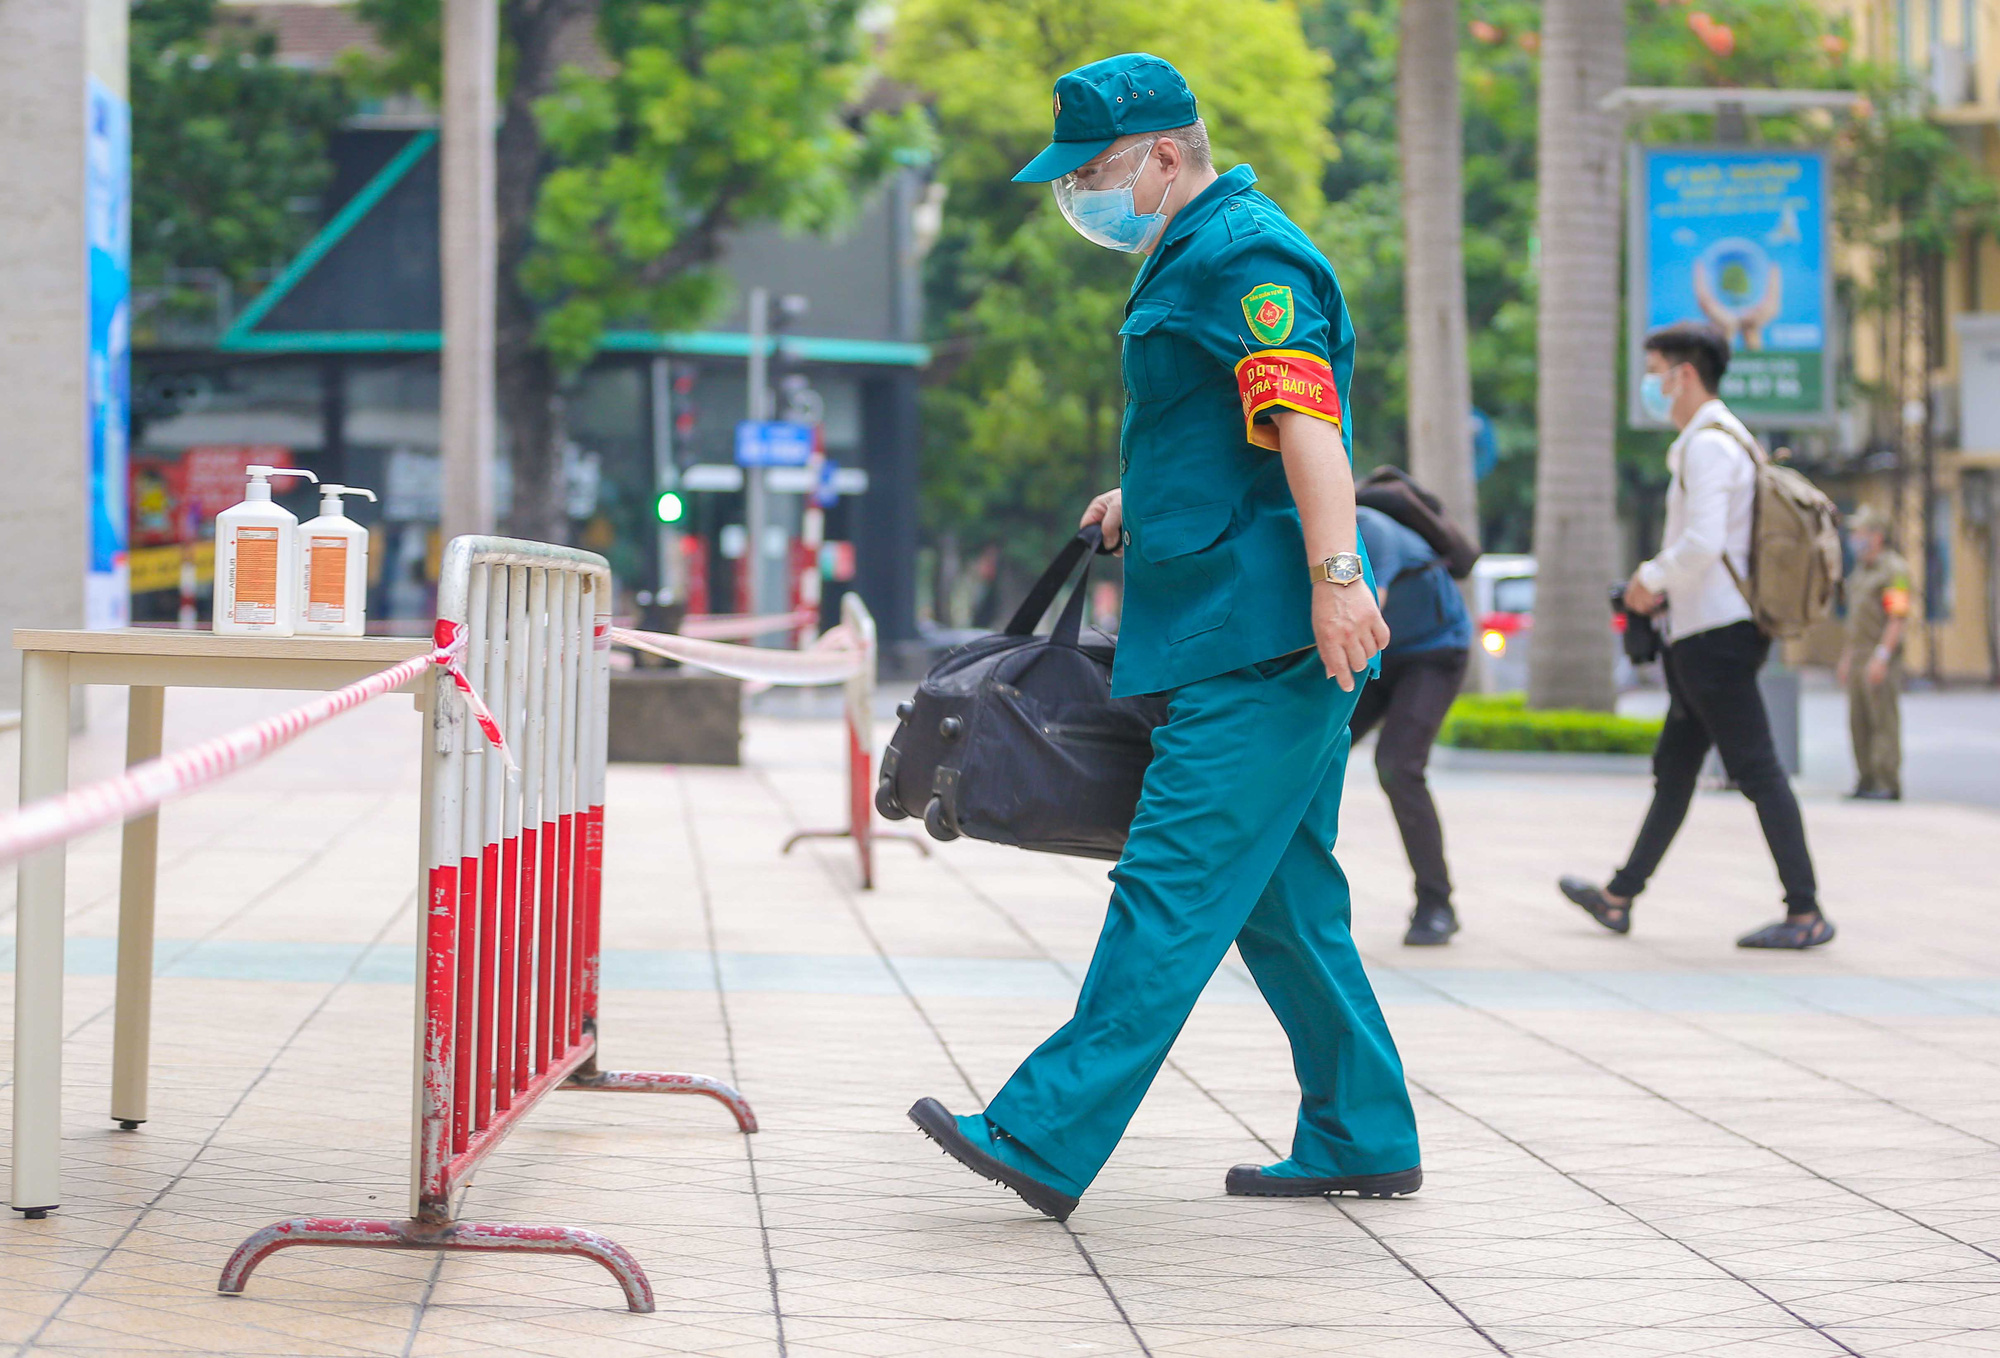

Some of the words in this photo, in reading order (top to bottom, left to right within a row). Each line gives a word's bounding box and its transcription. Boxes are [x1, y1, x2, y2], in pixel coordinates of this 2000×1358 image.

[1247, 364, 1289, 383] DQTV
[1250, 379, 1271, 397] TRA
[1308, 382, 1324, 404] VỆ
